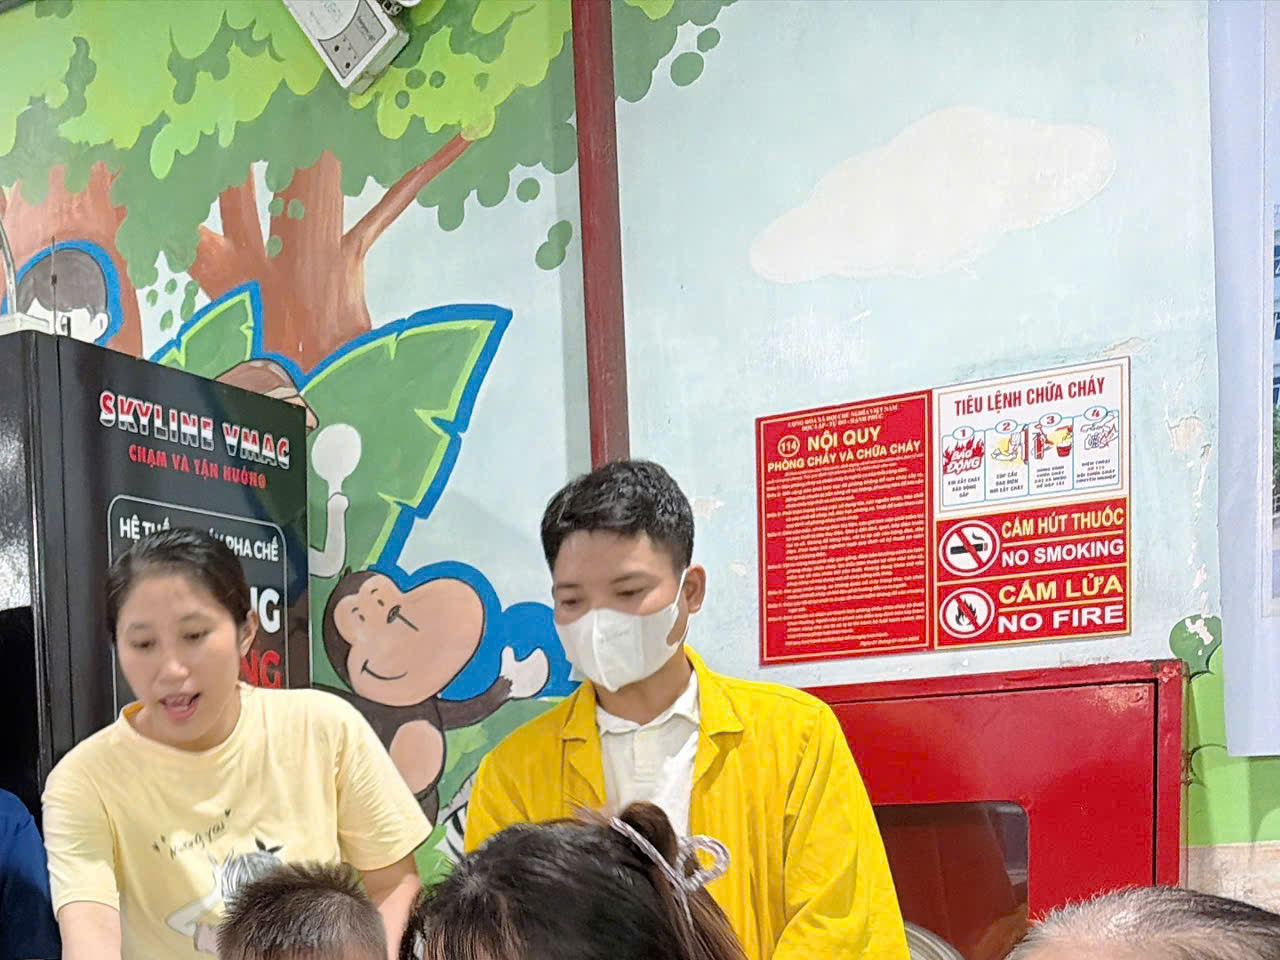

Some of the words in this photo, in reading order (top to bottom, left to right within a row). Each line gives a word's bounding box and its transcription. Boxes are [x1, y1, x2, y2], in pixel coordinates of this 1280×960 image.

[954, 394, 983, 416] TIÊU
[987, 390, 1022, 414] LỆNH
[1026, 381, 1063, 405] CHỮA
[1068, 375, 1105, 398] CHÁY
[99, 390, 215, 452] SKYLINE
[222, 422, 290, 470] VMAC
[960, 429, 966, 437] 1
[1002, 422, 1011, 431] 2
[1047, 415, 1055, 425] 3
[781, 439, 797, 450] 114
[807, 431, 838, 451] NỘI
[843, 425, 882, 445] QUY
[128, 444, 168, 469] CHẠM
[172, 453, 190, 473] VÀ
[194, 458, 219, 481] TẬN
[768, 458, 804, 472] PHÒNG
[807, 451, 837, 466] CHÁY
[839, 449, 854, 462] VÀ
[856, 444, 887, 459] CHỮA
[890, 439, 921, 454] CHÁY
[1038, 511, 1068, 534] HÚT
[1071, 505, 1124, 530] THUỐC
[120, 514, 140, 543] HỆ
[253, 535, 280, 562] CHẾ
[1002, 549, 1029, 568] NO
[1034, 538, 1124, 564] SMOKING
[1066, 573, 1124, 598] LỬA
[998, 612, 1043, 634] NO
[1053, 604, 1124, 629] FIRE
